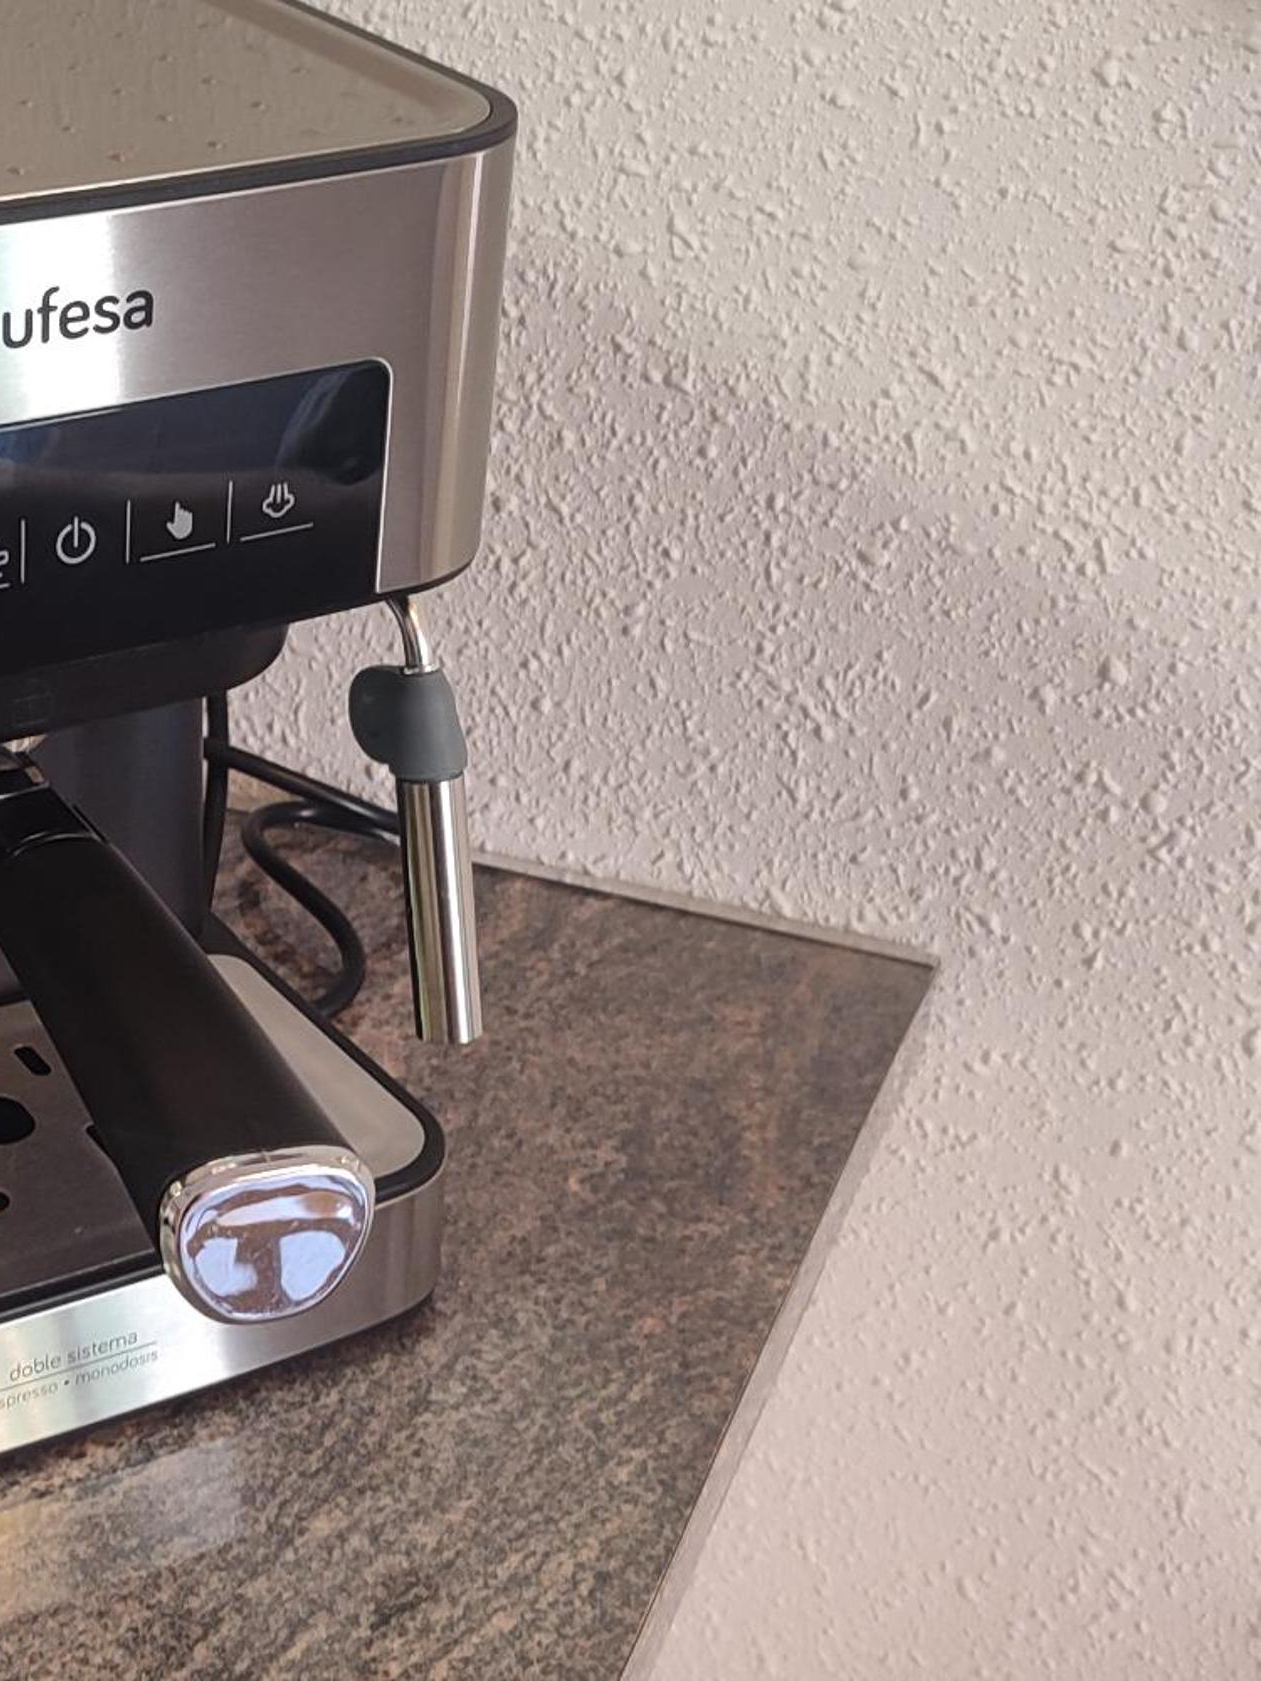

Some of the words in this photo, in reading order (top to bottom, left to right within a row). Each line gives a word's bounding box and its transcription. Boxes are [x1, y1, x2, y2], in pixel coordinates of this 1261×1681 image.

[2, 286, 154, 349] ufesa
[9, 1354, 62, 1382] doble
[67, 1331, 138, 1365] sistema
[74, 1350, 160, 1386] monodosis
